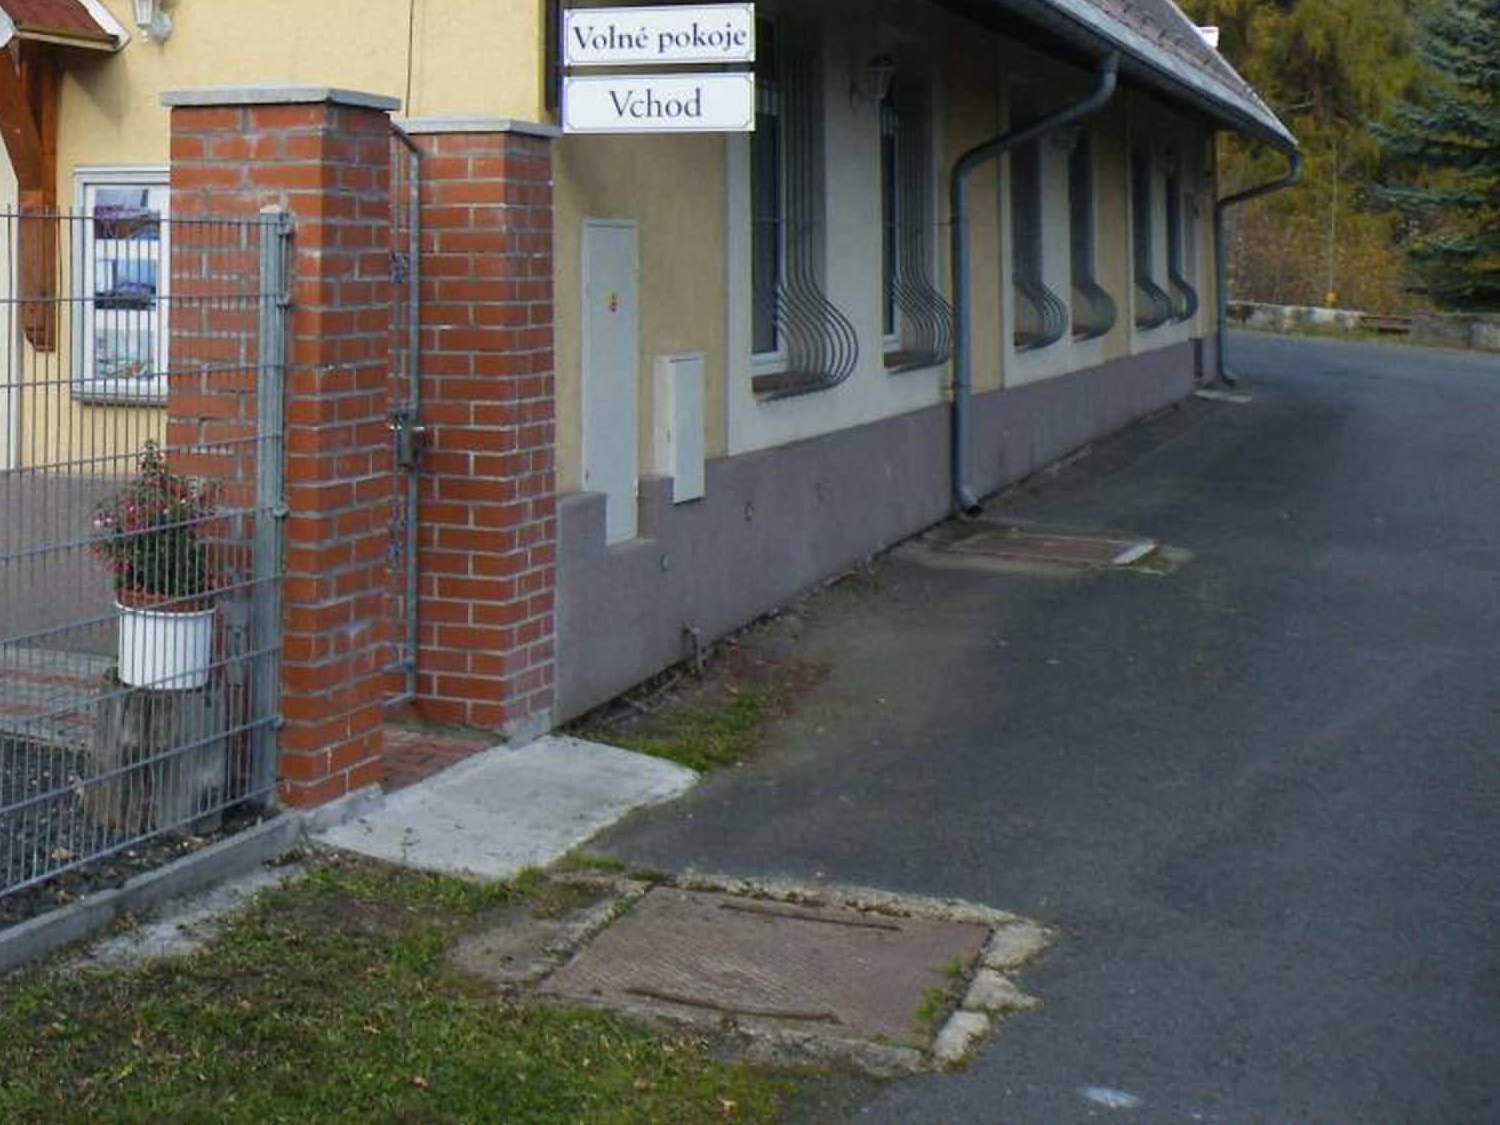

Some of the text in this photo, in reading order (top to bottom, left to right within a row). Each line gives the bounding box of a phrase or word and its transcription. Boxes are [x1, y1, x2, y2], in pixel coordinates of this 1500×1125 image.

[574, 22, 747, 54] Volné pokoje
[608, 87, 703, 119] Vchod
